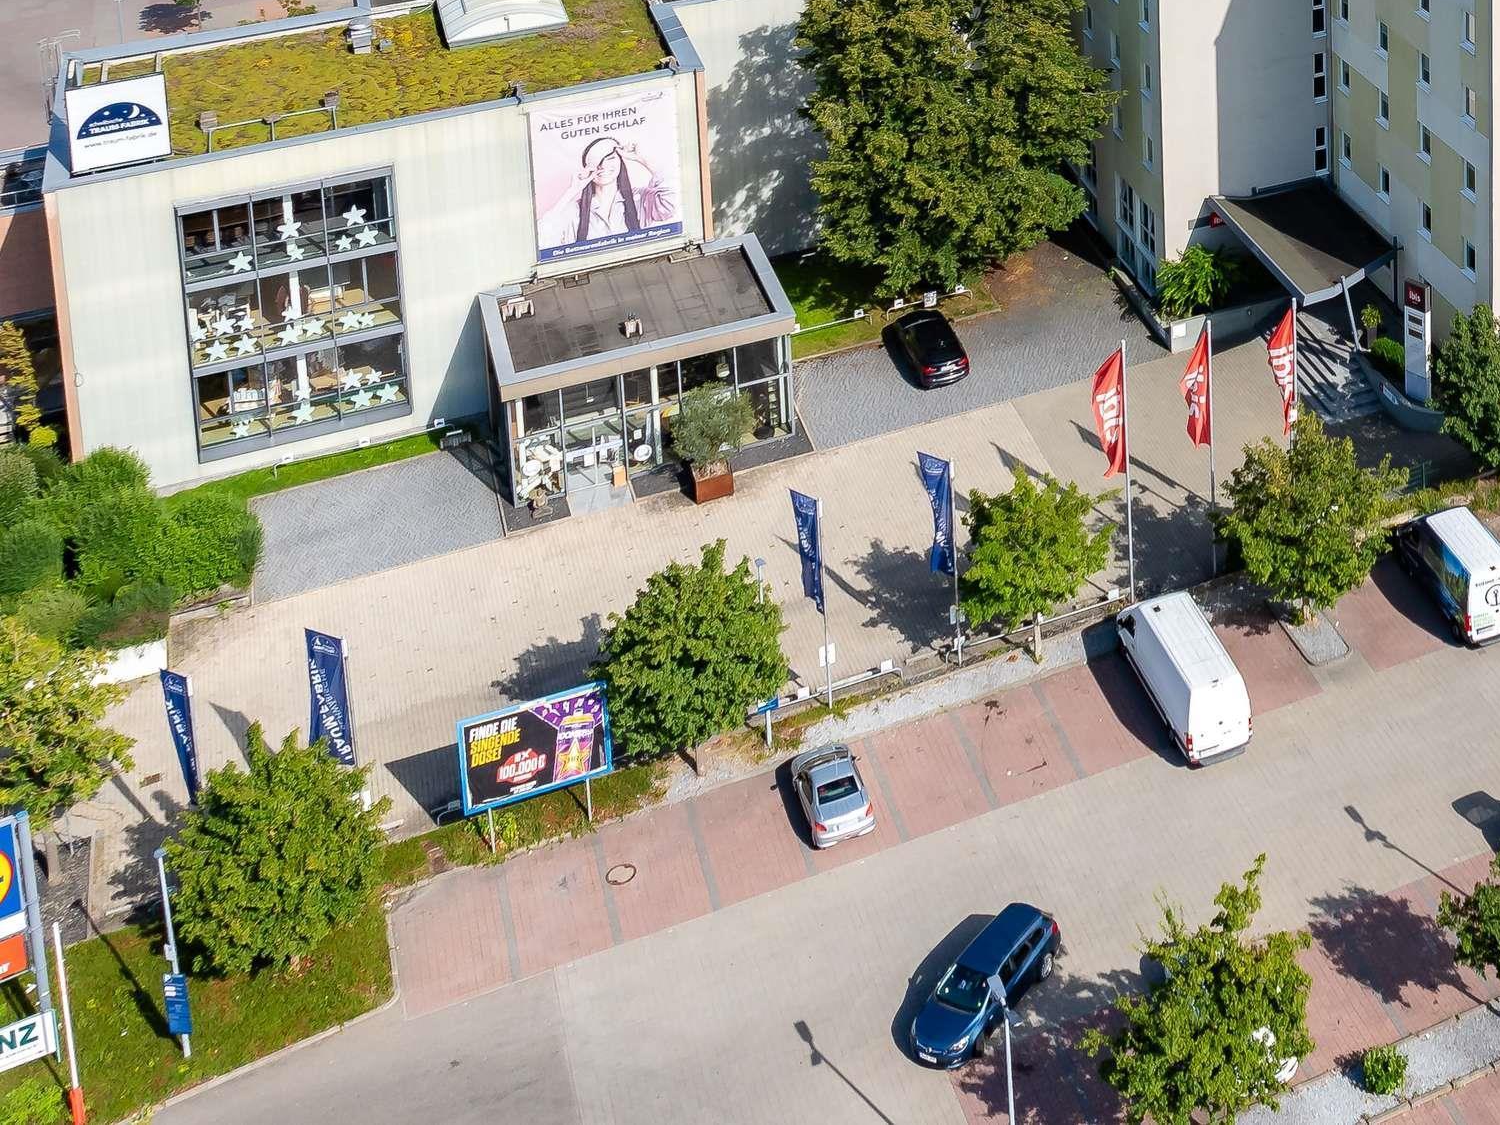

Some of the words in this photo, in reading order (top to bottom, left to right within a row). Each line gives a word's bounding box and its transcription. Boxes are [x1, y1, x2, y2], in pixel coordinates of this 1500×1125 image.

[540, 118, 574, 132] ALLES
[577, 113, 599, 125] FÜR
[602, 106, 637, 121] IHREN
[560, 127, 600, 140] GUTEN
[603, 116, 646, 133] SCHLAF
[469, 721, 499, 743] FINDE
[500, 716, 518, 733] DIE
[470, 728, 521, 755] SINGENDE
